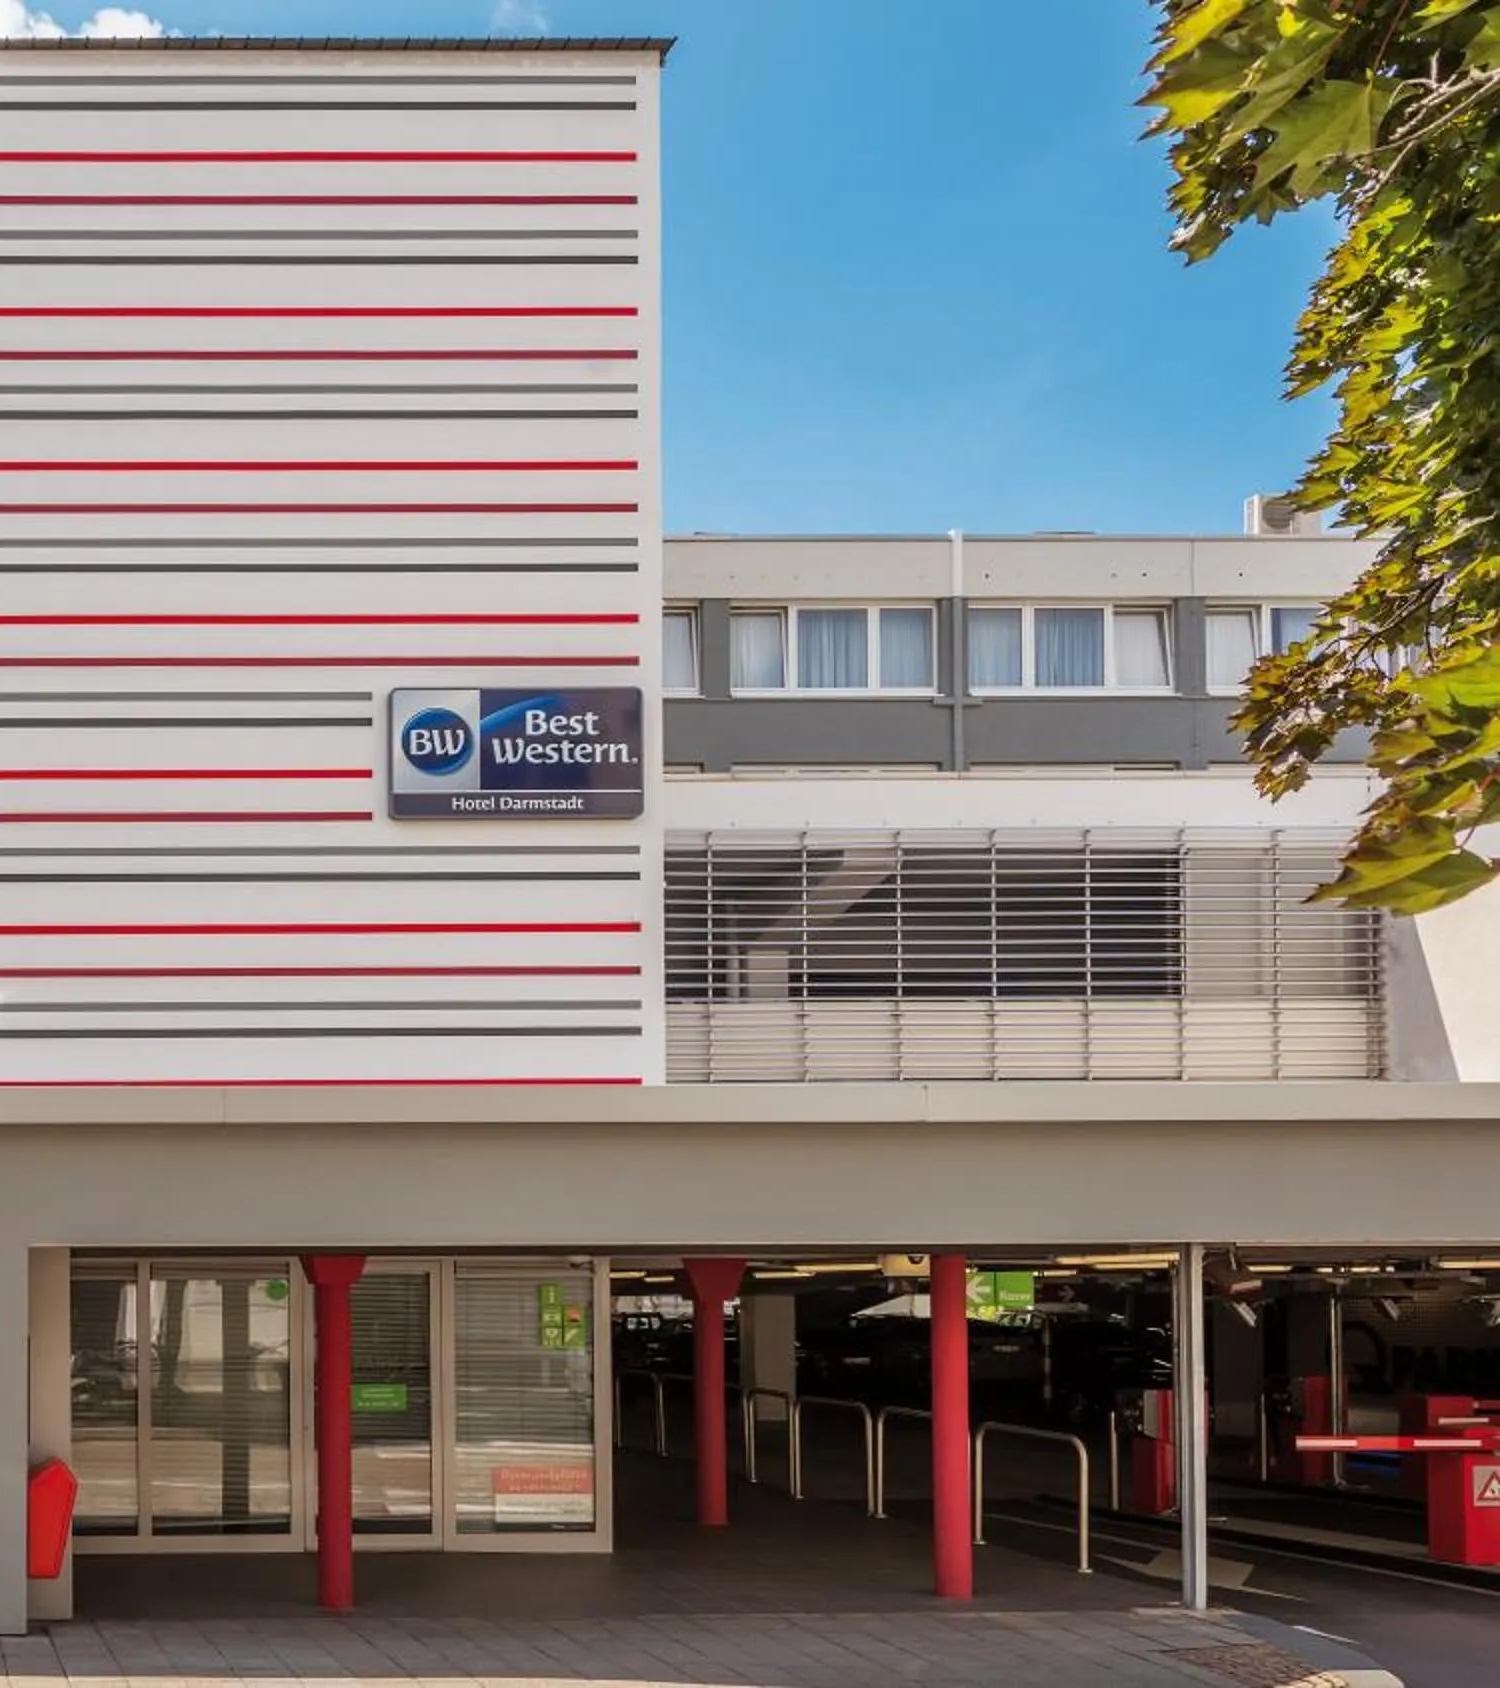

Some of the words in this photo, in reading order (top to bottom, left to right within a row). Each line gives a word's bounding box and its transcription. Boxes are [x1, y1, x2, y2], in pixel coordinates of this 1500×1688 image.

[525, 709, 599, 736] Best
[409, 729, 465, 756] BW
[451, 797, 495, 811] Hotel
[499, 796, 584, 811] Darmstadt
